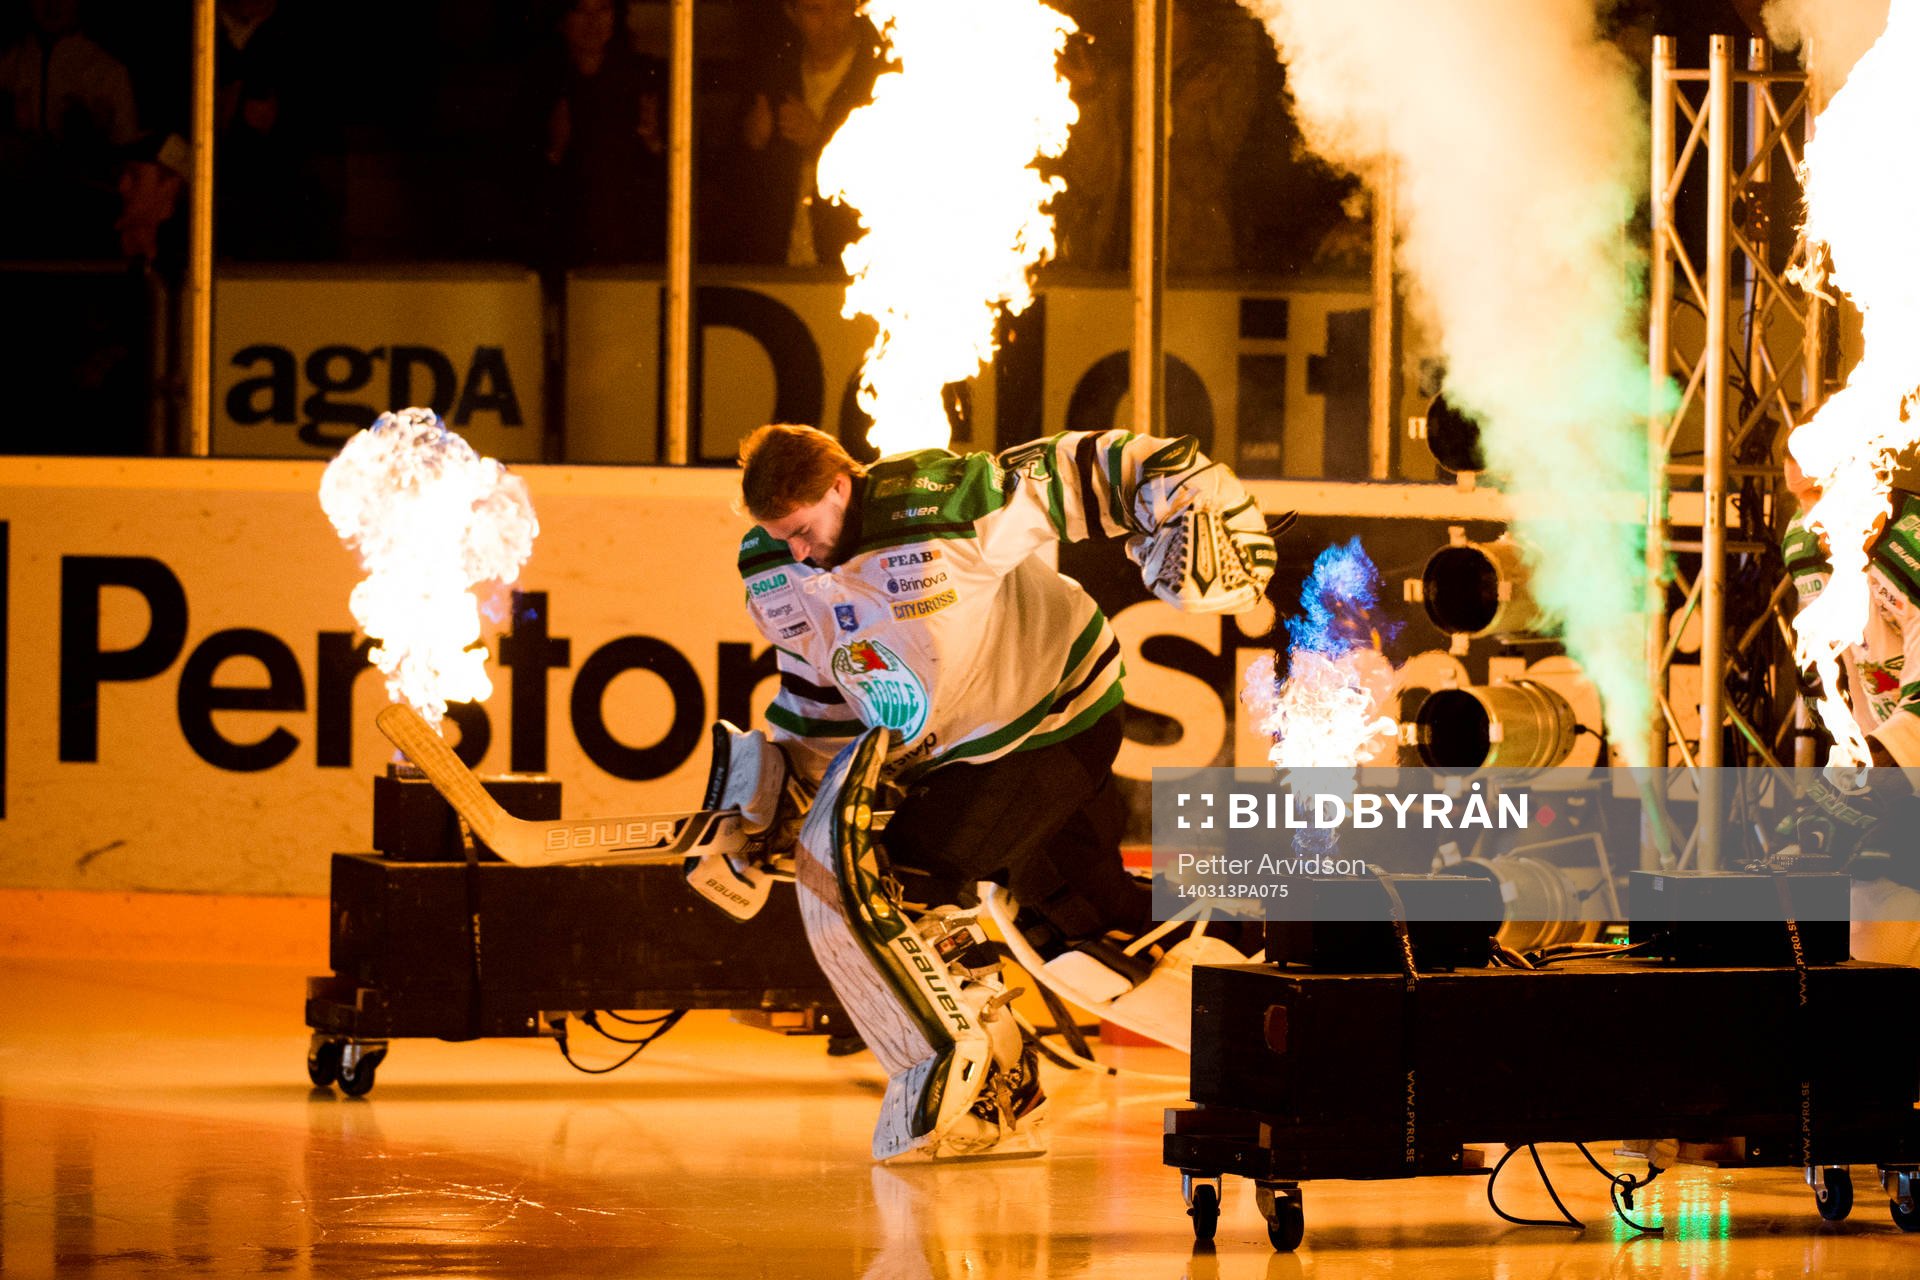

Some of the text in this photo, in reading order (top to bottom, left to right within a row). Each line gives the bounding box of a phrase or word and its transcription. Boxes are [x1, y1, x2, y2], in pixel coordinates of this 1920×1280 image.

[887, 551, 934, 568] PEAB
[752, 573, 788, 596] SOLID
[900, 571, 948, 592] Brinova
[893, 591, 955, 619] CITY GROSS
[1406, 1069, 1415, 1163] WWW.PYRO.SE
